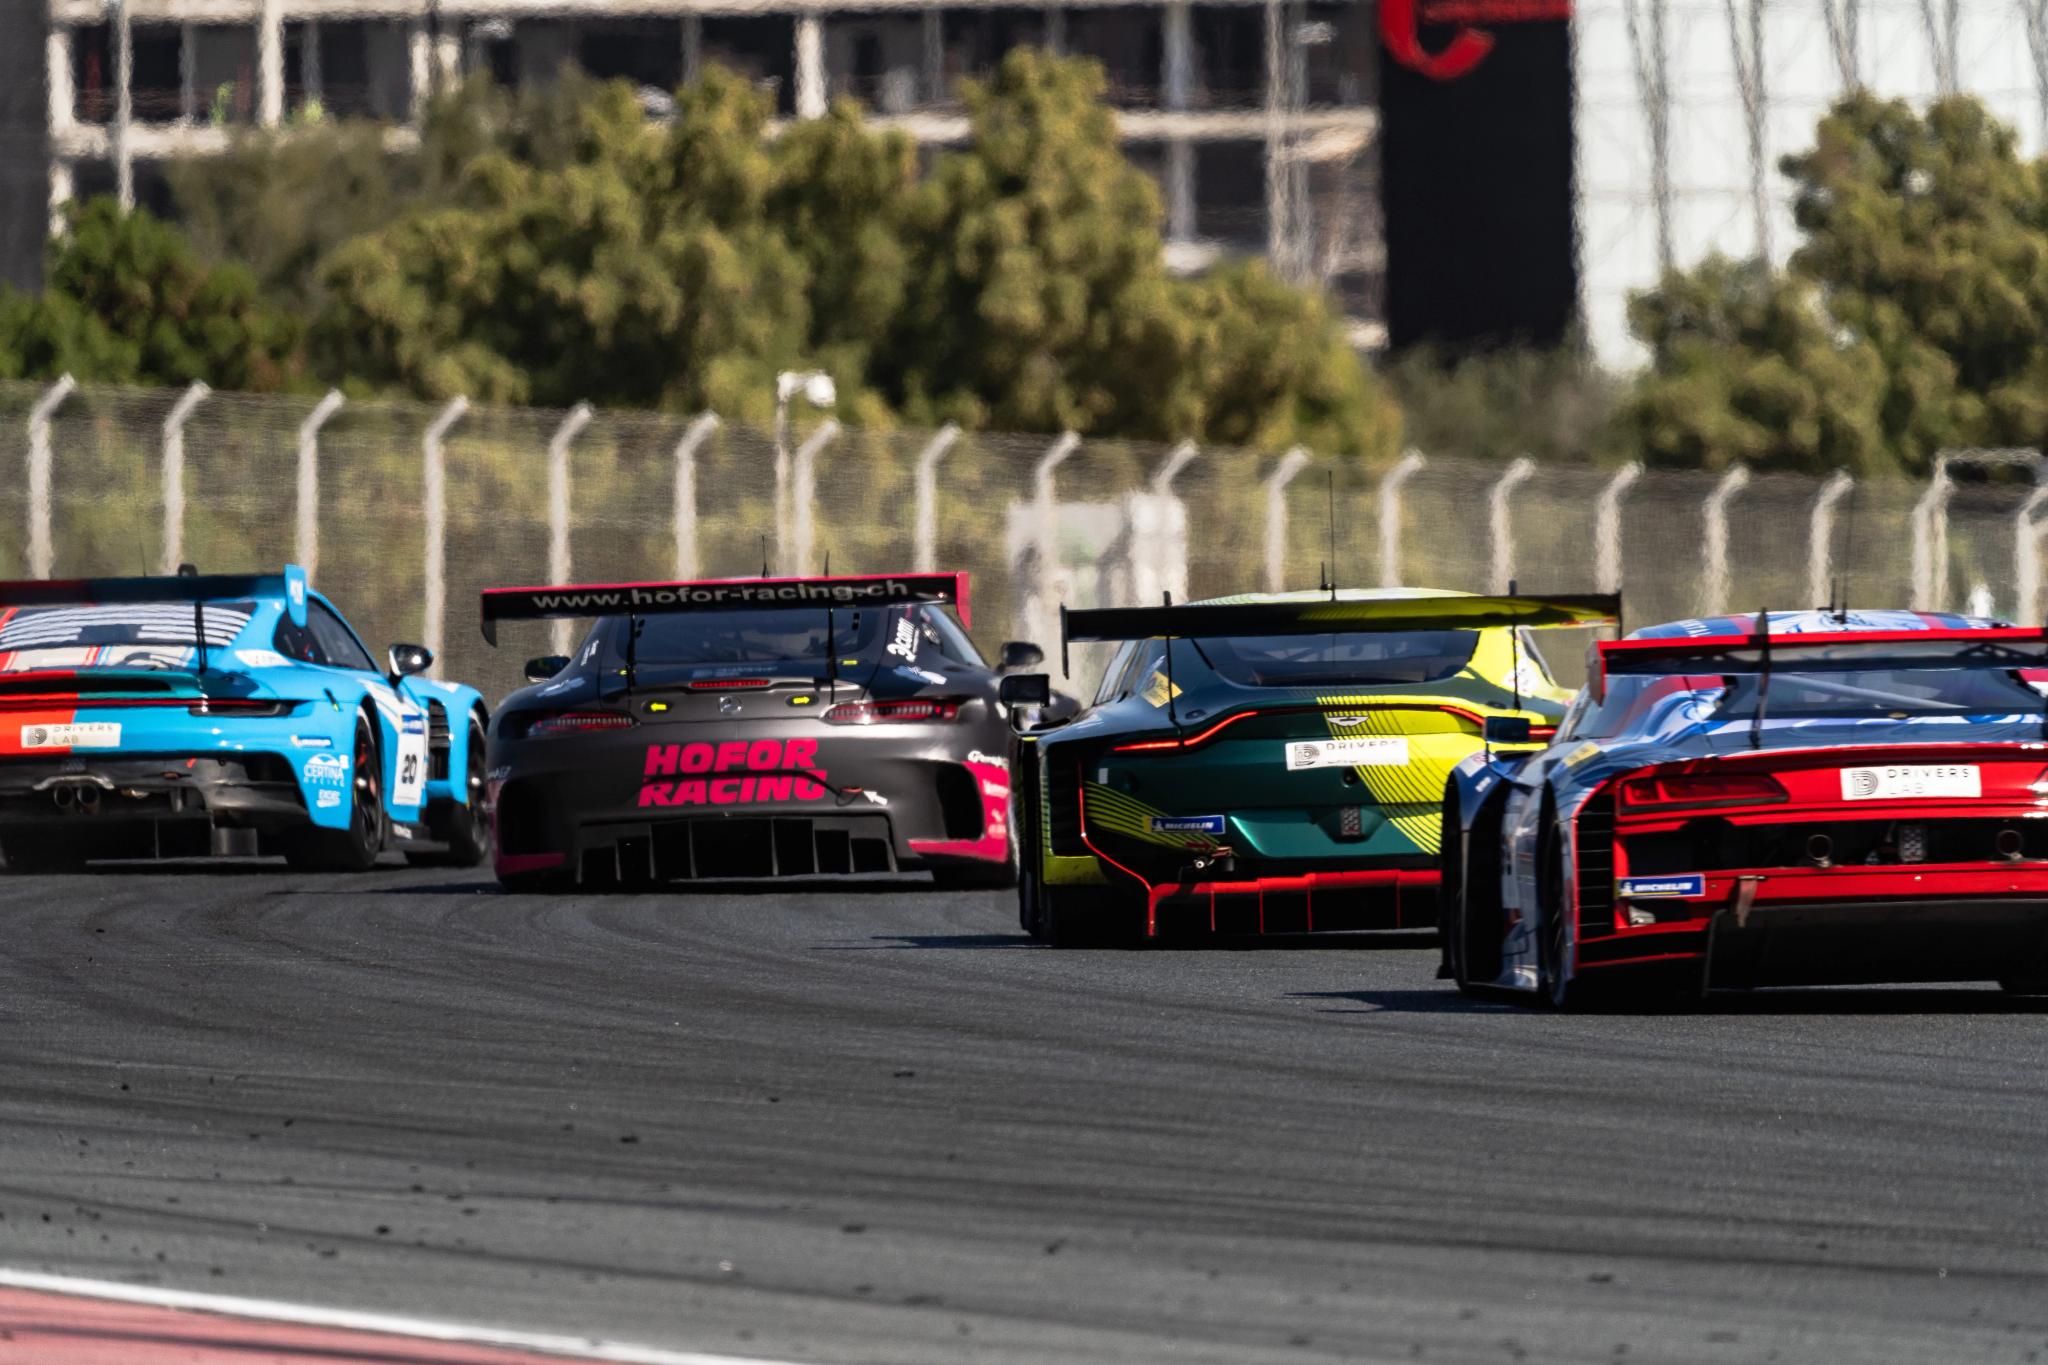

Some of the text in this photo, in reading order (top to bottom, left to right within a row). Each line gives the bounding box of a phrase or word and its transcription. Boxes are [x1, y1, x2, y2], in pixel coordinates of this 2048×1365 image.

[532, 578, 909, 609] www.hofor-racing.ch
[401, 753, 418, 785] 20
[643, 737, 819, 776] HOFOR
[637, 769, 828, 808] RACING
[1887, 768, 1970, 779] DRIVERS
[1164, 820, 1215, 831] MICHELIN
